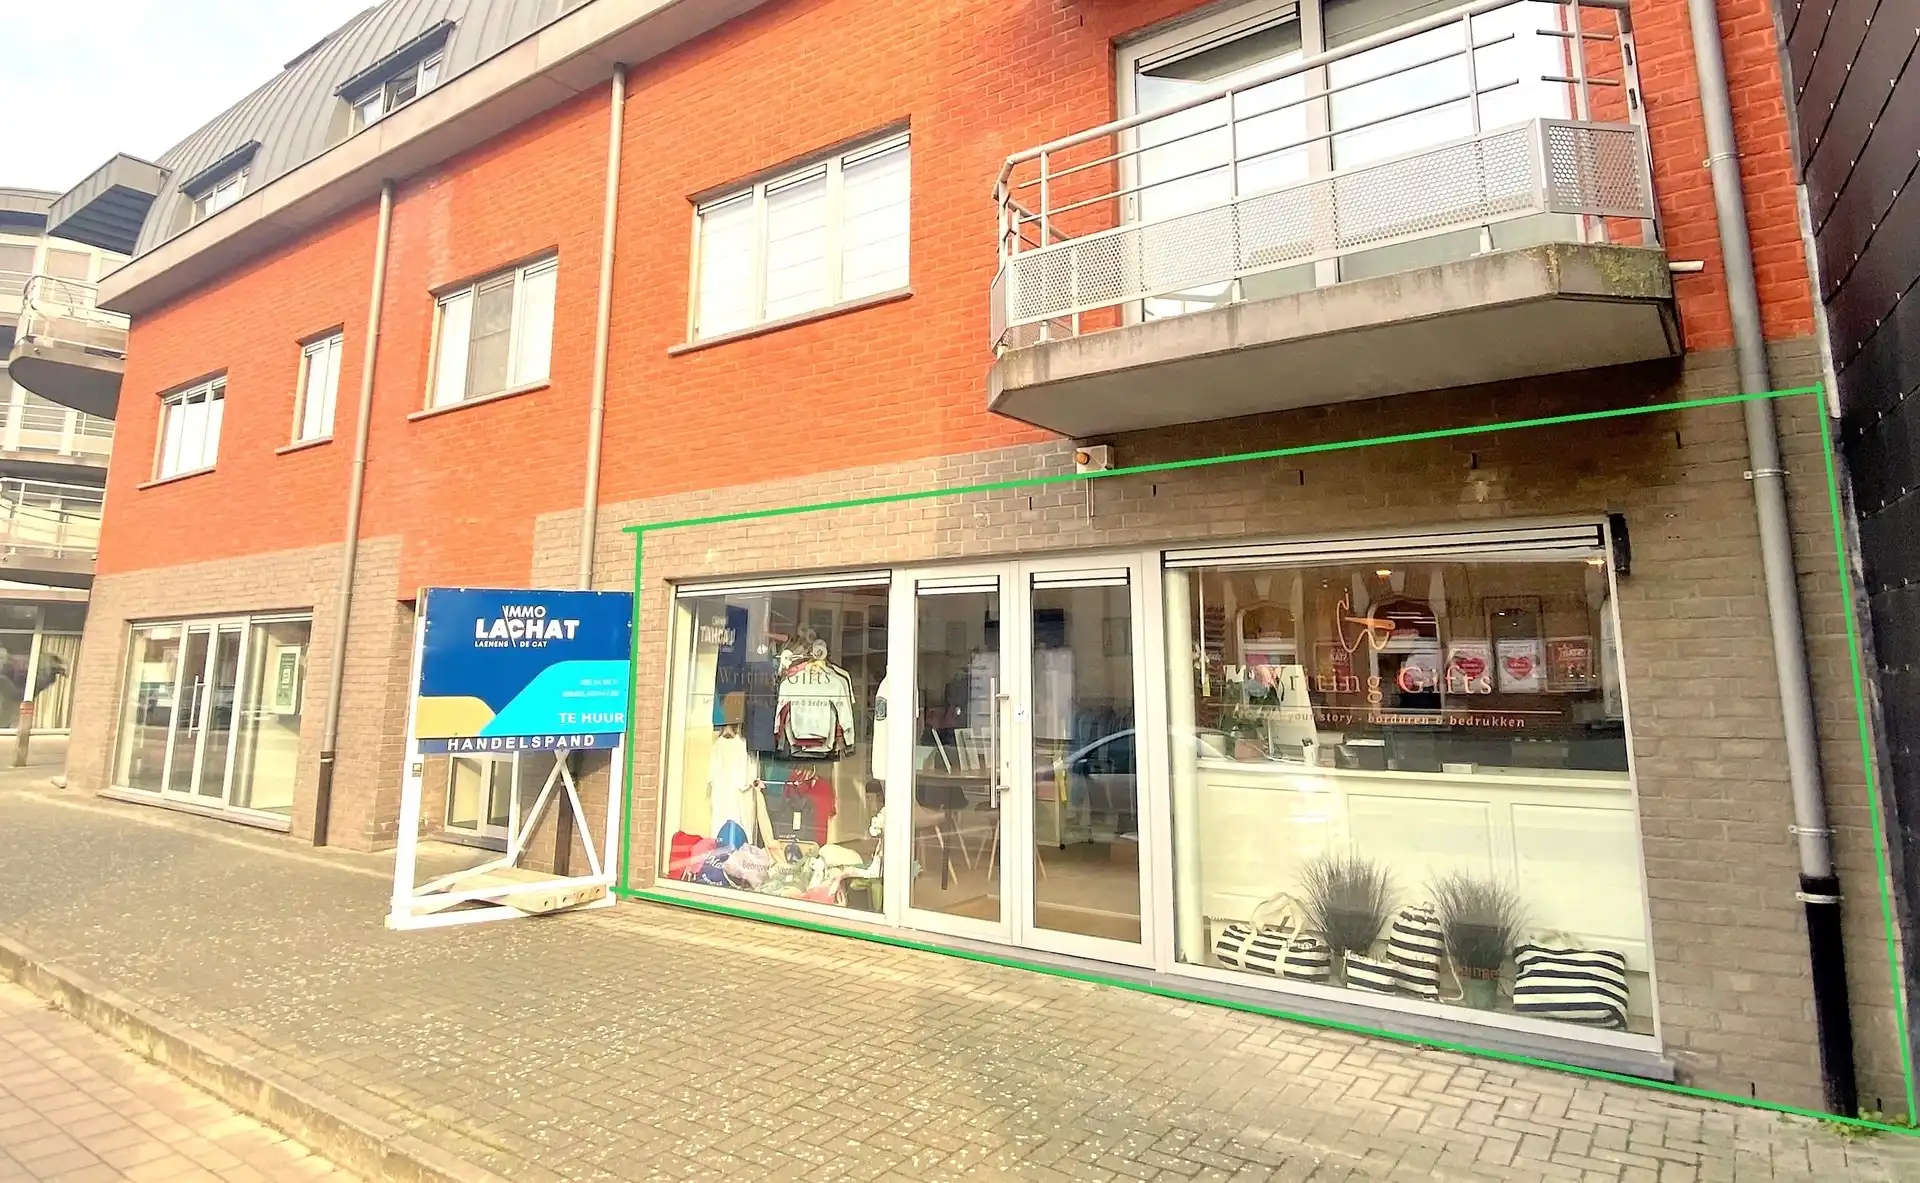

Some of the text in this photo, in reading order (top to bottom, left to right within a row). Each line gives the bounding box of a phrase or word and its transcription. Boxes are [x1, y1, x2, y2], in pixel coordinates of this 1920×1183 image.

[503, 605, 546, 618] IMMO
[475, 618, 580, 640] LACHAT
[1399, 665, 1493, 694] Gifts
[558, 712, 624, 723] TE HUUR
[1319, 711, 1354, 724] story
[1449, 715, 1526, 728] bedrukken
[447, 735, 595, 751] HANDELSPAND
